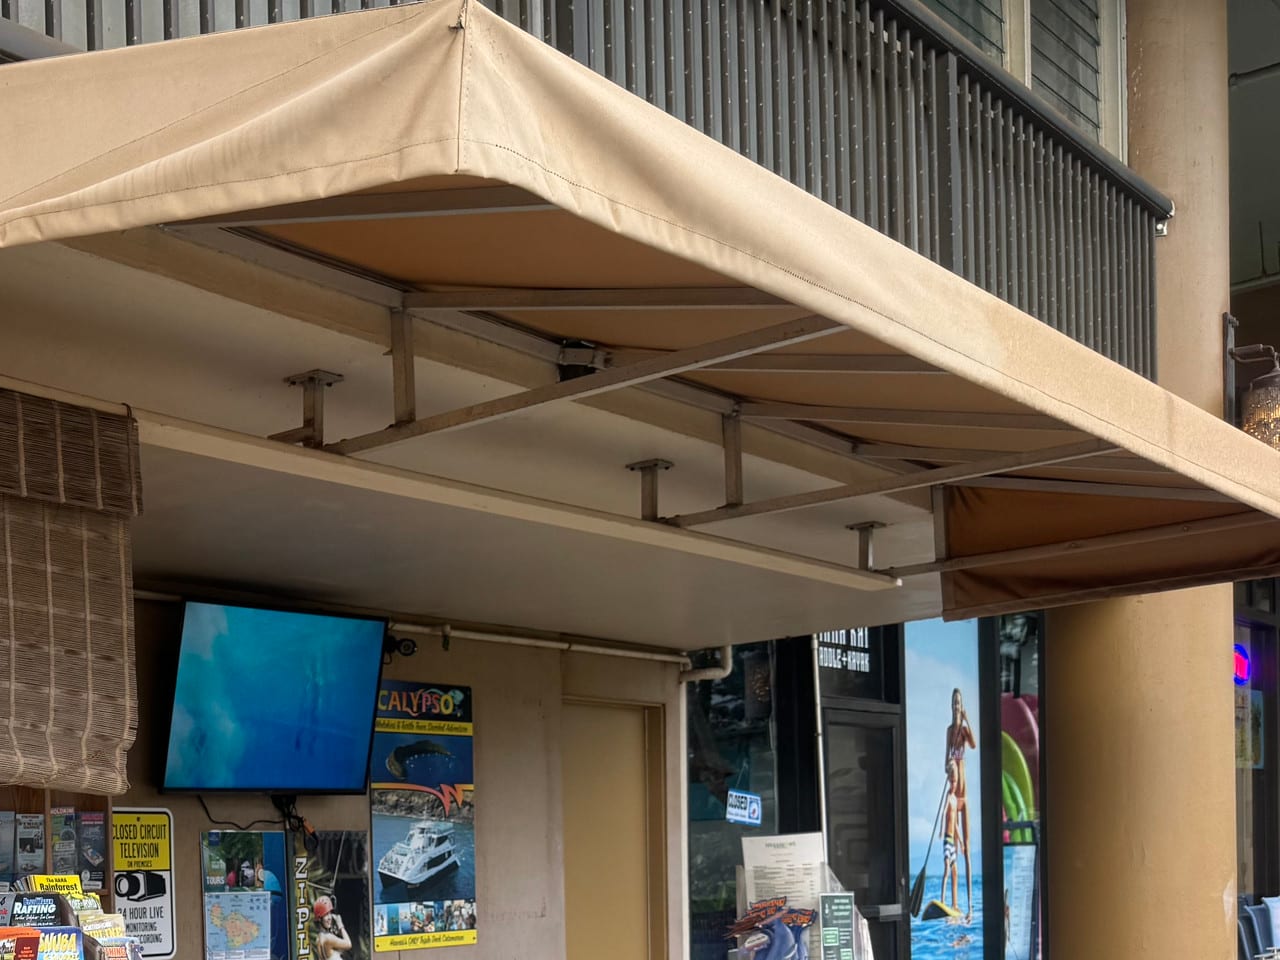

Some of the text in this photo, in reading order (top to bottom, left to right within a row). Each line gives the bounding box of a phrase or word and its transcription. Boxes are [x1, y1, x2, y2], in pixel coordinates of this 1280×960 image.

[378, 689, 454, 716] CALYPSO
[140, 824, 167, 841] CIRCUIT
[120, 843, 159, 859] TELEVISION
[127, 860, 153, 868] ON PREMISES
[40, 882, 79, 891] Rainforest
[206, 875, 225, 886] TOURS
[13, 901, 57, 914] RAFTING
[129, 906, 147, 920] HOUR
[149, 906, 164, 919] LIVE
[38, 932, 77, 953] SNUBA
